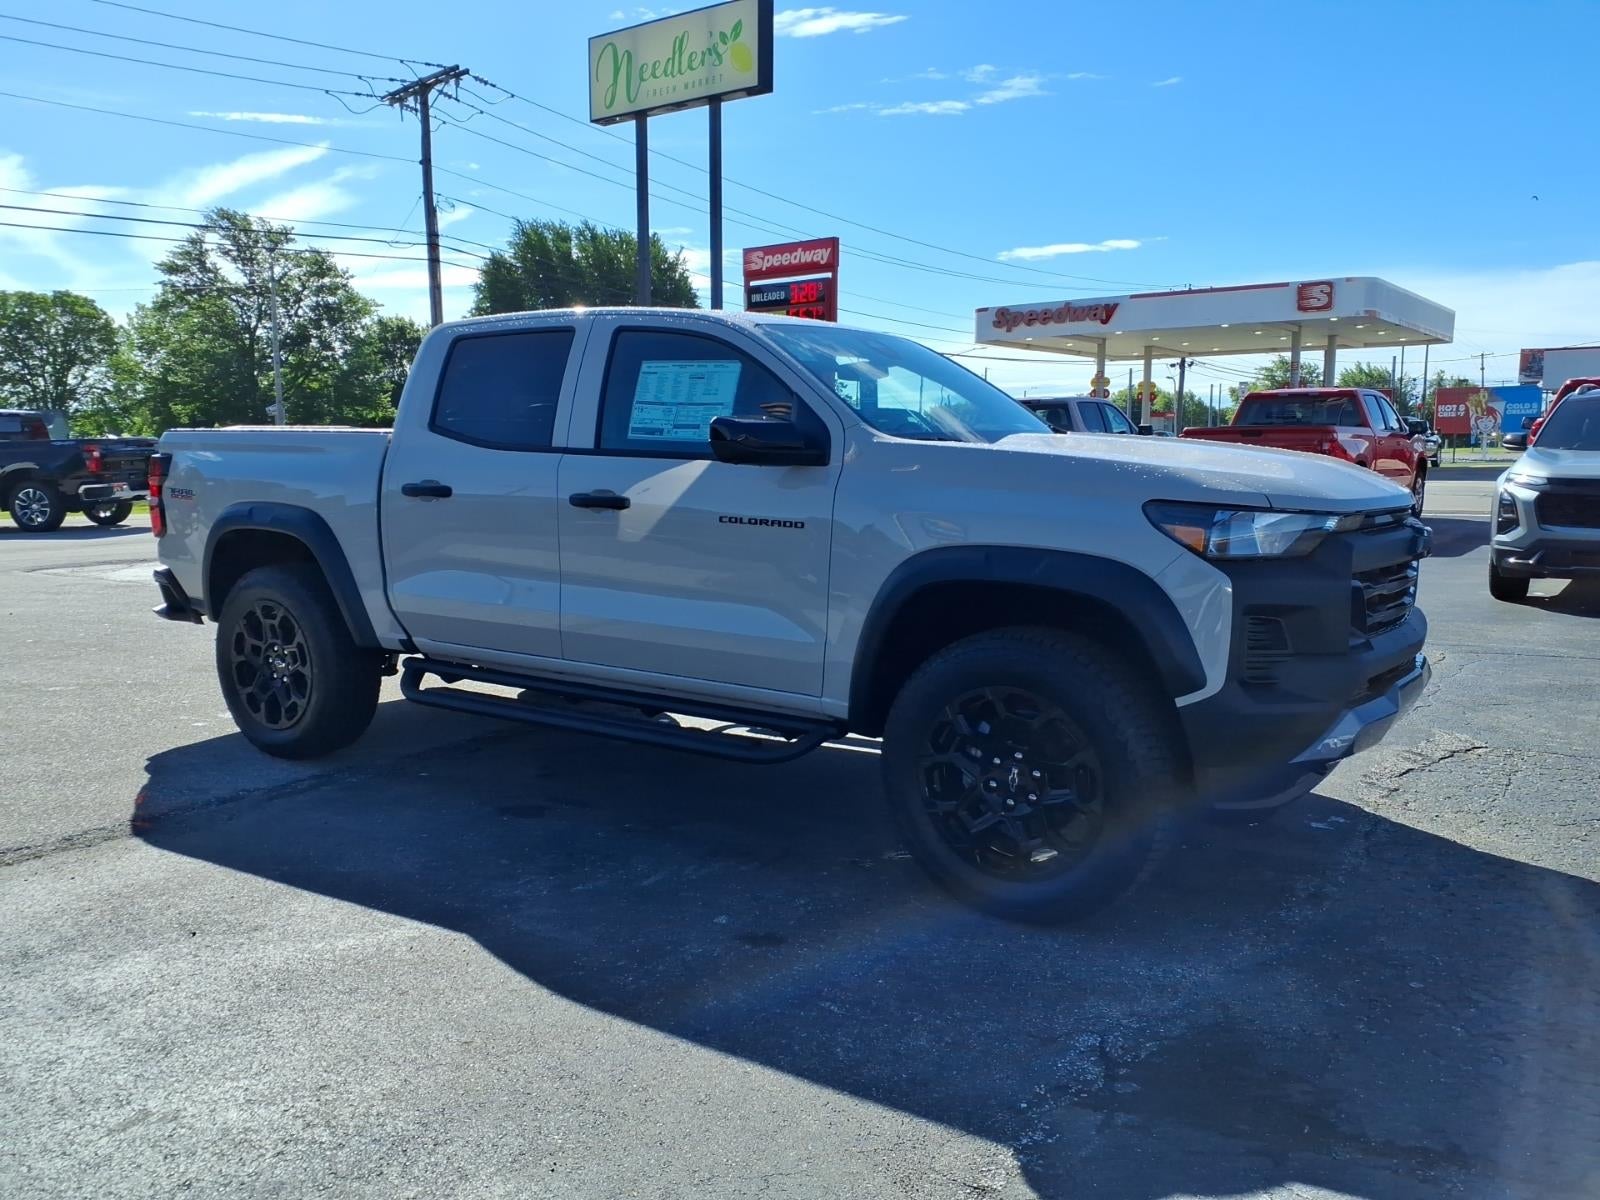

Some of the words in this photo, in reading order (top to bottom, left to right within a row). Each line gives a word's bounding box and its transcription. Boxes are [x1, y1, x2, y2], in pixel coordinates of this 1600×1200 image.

[595, 30, 729, 109] Needler's
[646, 85, 677, 98] FRESH
[684, 73, 723, 90] MARKET
[744, 247, 832, 271] Speedway
[751, 291, 786, 303] UNLEADED
[992, 302, 1120, 333] Speedway
[1437, 404, 1457, 412] HOT
[1505, 402, 1531, 410] COLD
[718, 515, 805, 529] COLORADO
